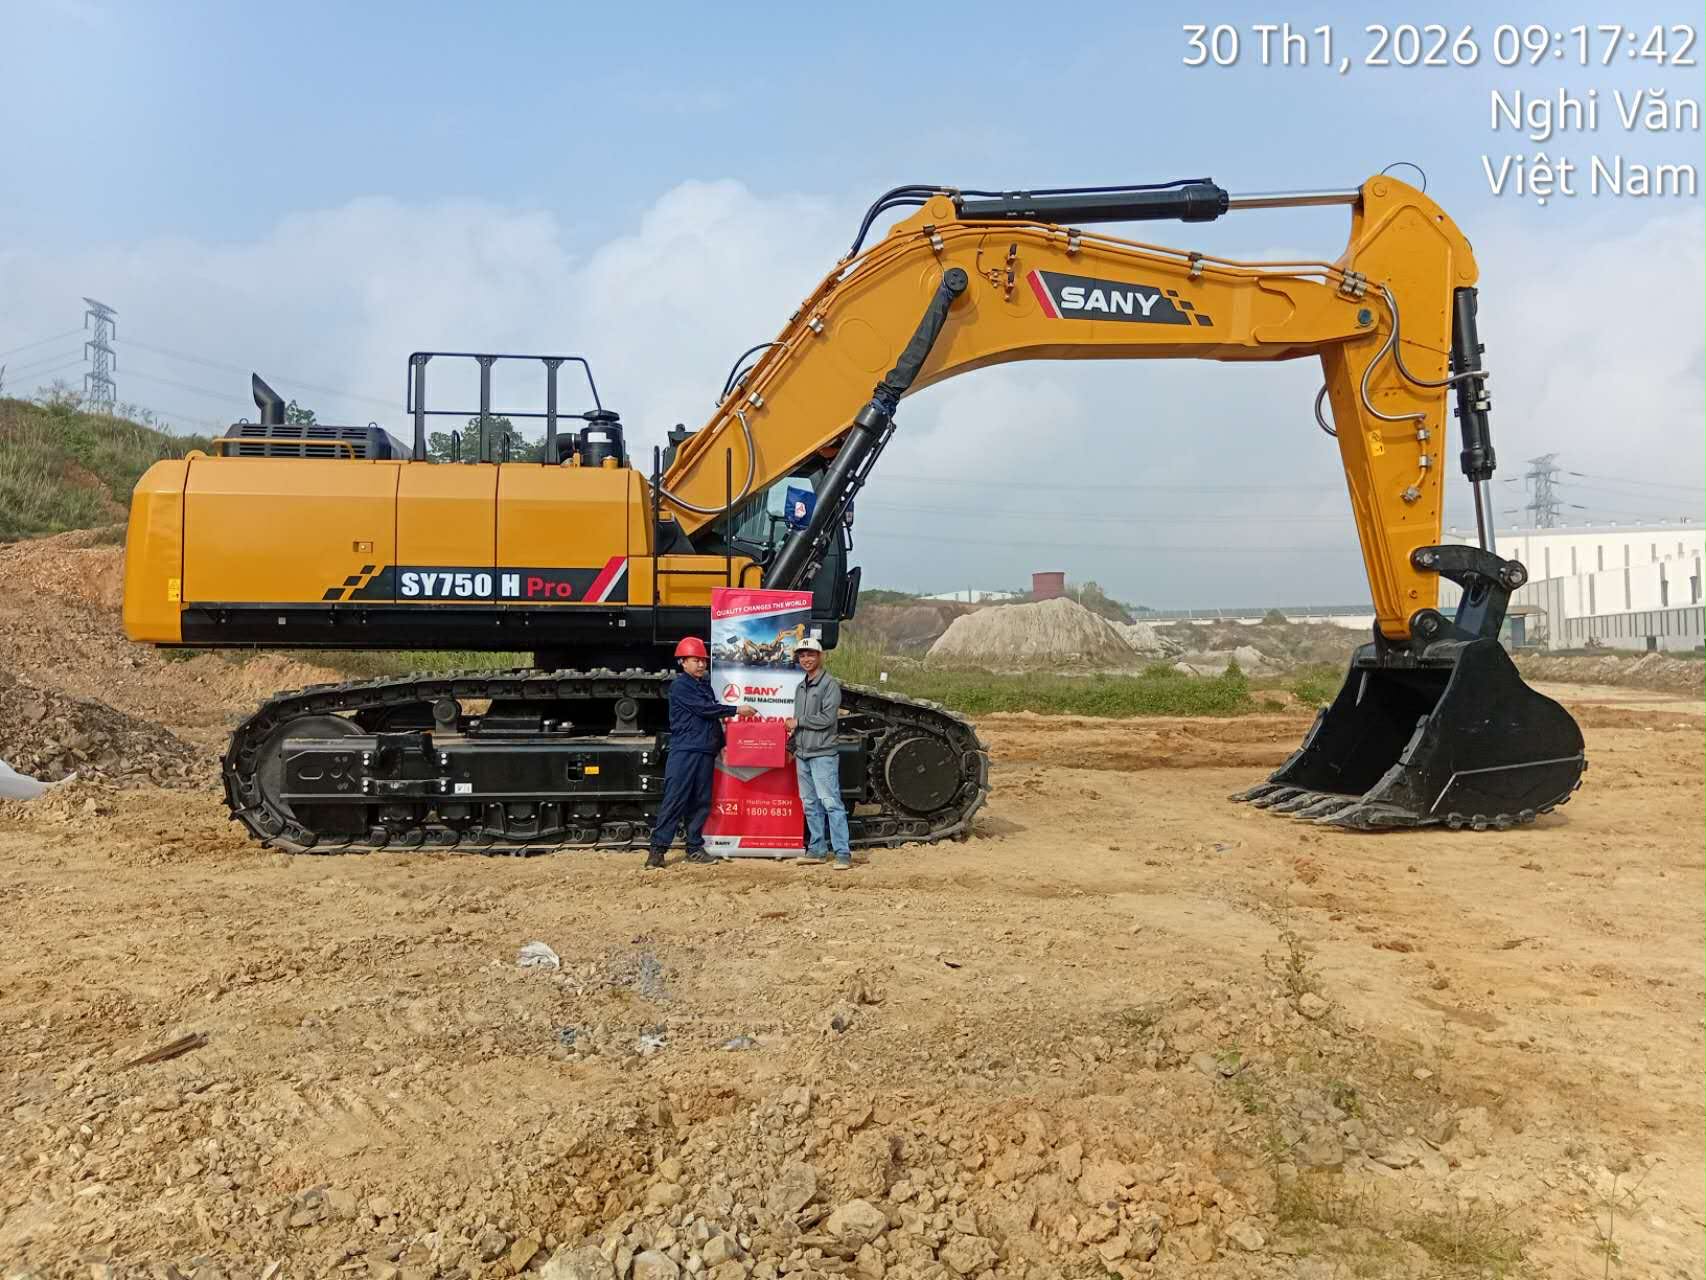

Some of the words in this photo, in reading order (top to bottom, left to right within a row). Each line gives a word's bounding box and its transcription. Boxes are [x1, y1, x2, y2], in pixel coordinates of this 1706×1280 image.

[1060, 286, 1161, 316] SANY
[401, 572, 492, 597] SY750
[501, 574, 520, 597] H
[527, 577, 573, 597] Pro
[716, 607, 743, 617] QUALITY
[743, 604, 772, 613] CHANGES
[785, 599, 807, 607] WORLD
[744, 686, 779, 696] SANY
[757, 697, 794, 705] MACHINERY
[725, 803, 738, 811] 24
[746, 807, 768, 816] 1800
[770, 807, 792, 817] 6831
